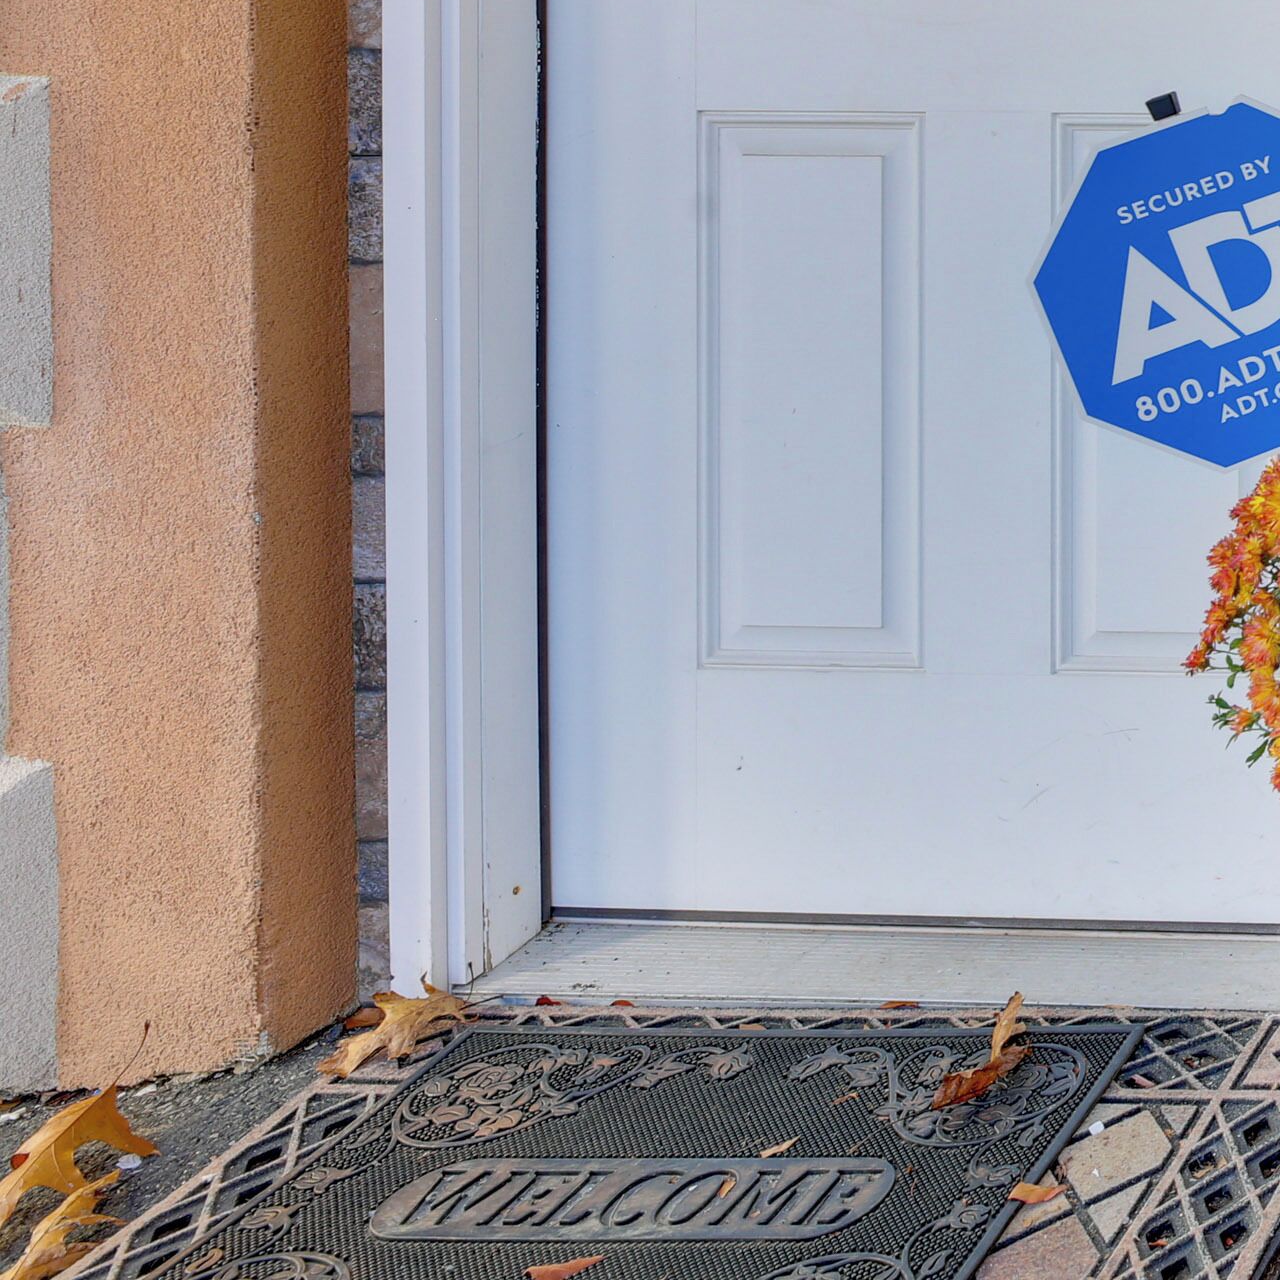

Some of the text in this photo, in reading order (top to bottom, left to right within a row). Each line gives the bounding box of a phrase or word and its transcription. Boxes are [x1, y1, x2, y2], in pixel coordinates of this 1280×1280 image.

[1116, 155, 1272, 225] SECURED BY
[398, 1167, 884, 1227] WELCOME
